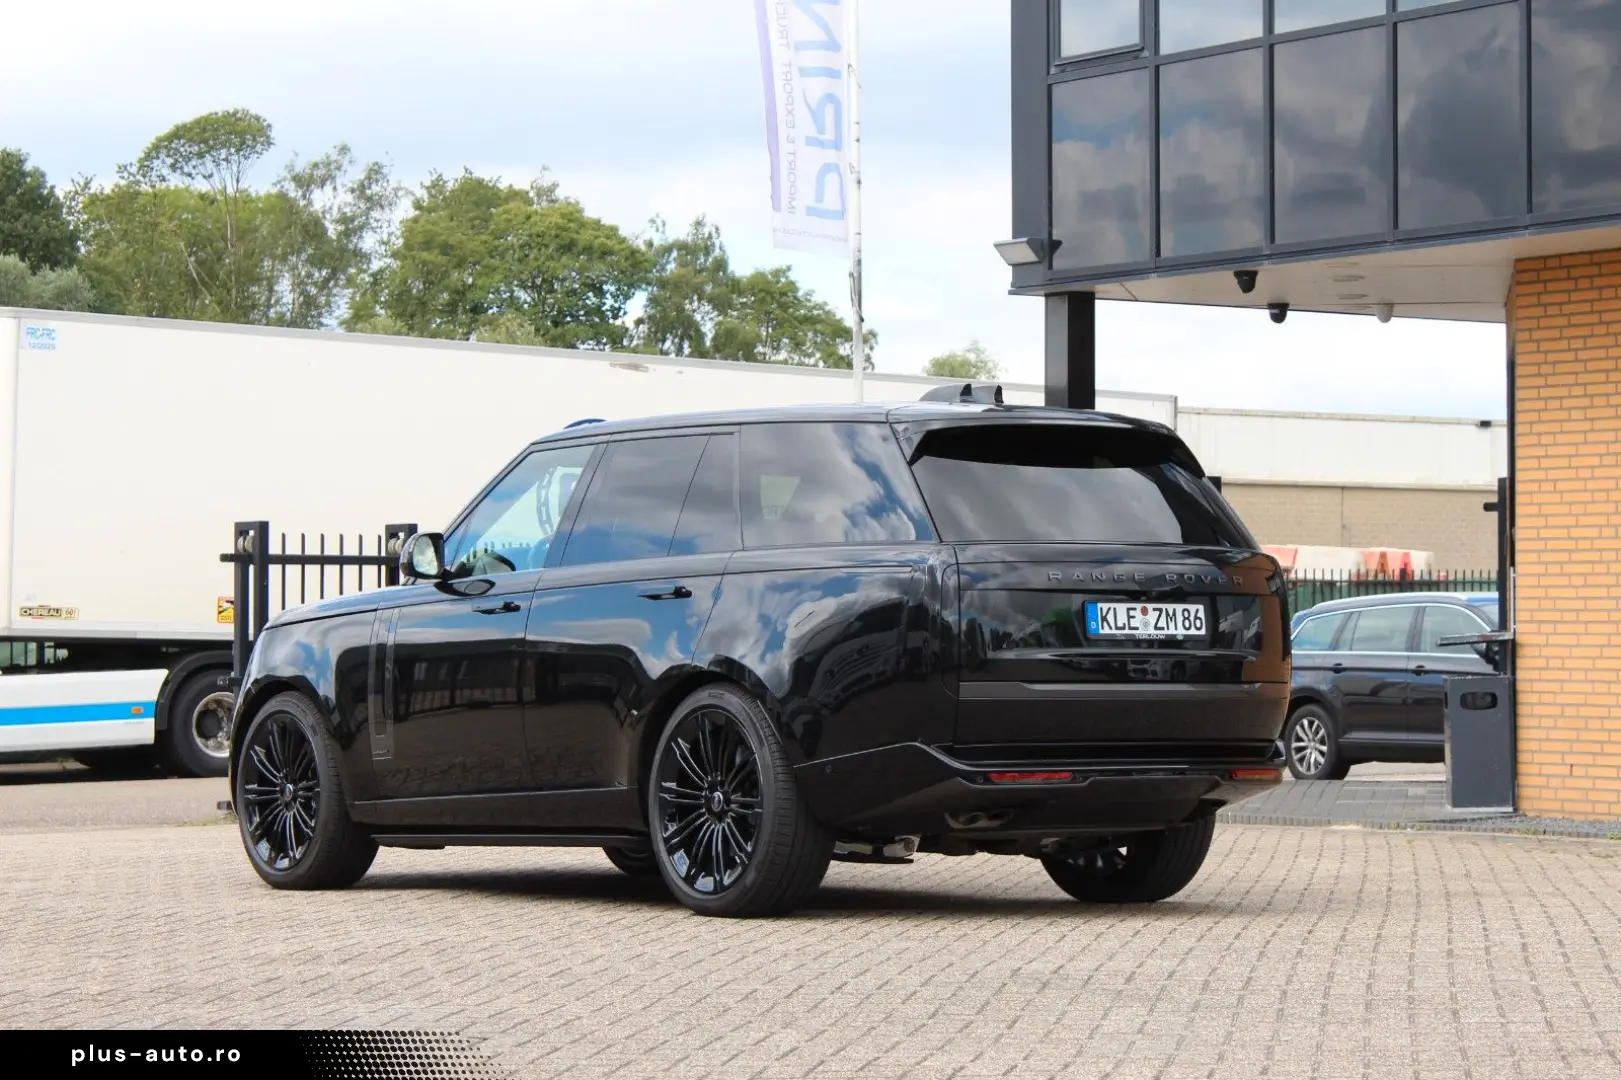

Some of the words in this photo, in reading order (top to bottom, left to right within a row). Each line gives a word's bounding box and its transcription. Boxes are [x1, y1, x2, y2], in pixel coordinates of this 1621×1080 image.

[1048, 571, 1147, 583] RANGE
[1165, 573, 1244, 586] ROVER
[21, 608, 61, 616] CHEREAU
[1099, 607, 1140, 631] KLE
[1152, 607, 1178, 631] ZM
[1181, 608, 1203, 631] 86
